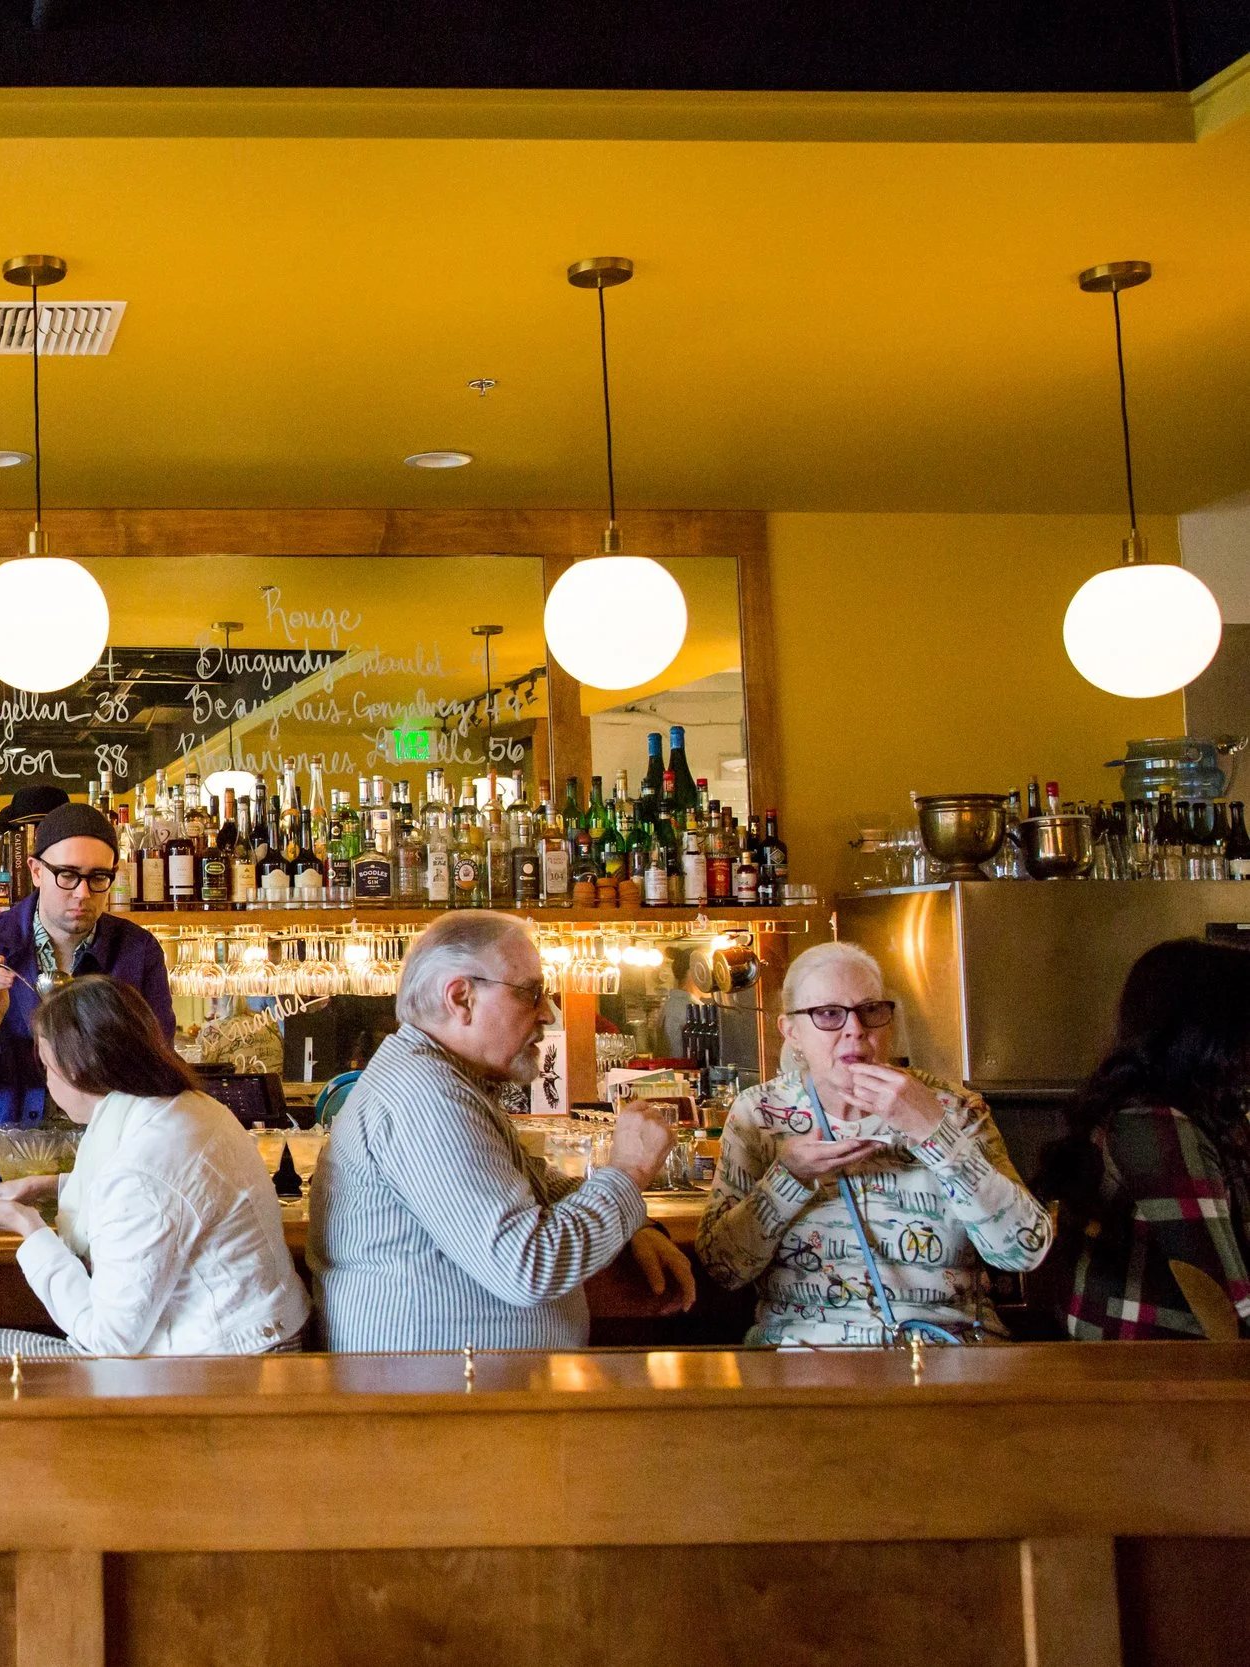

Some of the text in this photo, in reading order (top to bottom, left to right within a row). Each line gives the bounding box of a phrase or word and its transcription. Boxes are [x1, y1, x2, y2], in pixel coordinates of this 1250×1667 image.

[261, 586, 362, 647] Rouge
[93, 691, 130, 723] 38
[93, 743, 129, 777] 88
[489, 736, 524, 764] 56
[14, 833, 23, 869] CALVADOS
[358, 870, 388, 878] BOODLES
